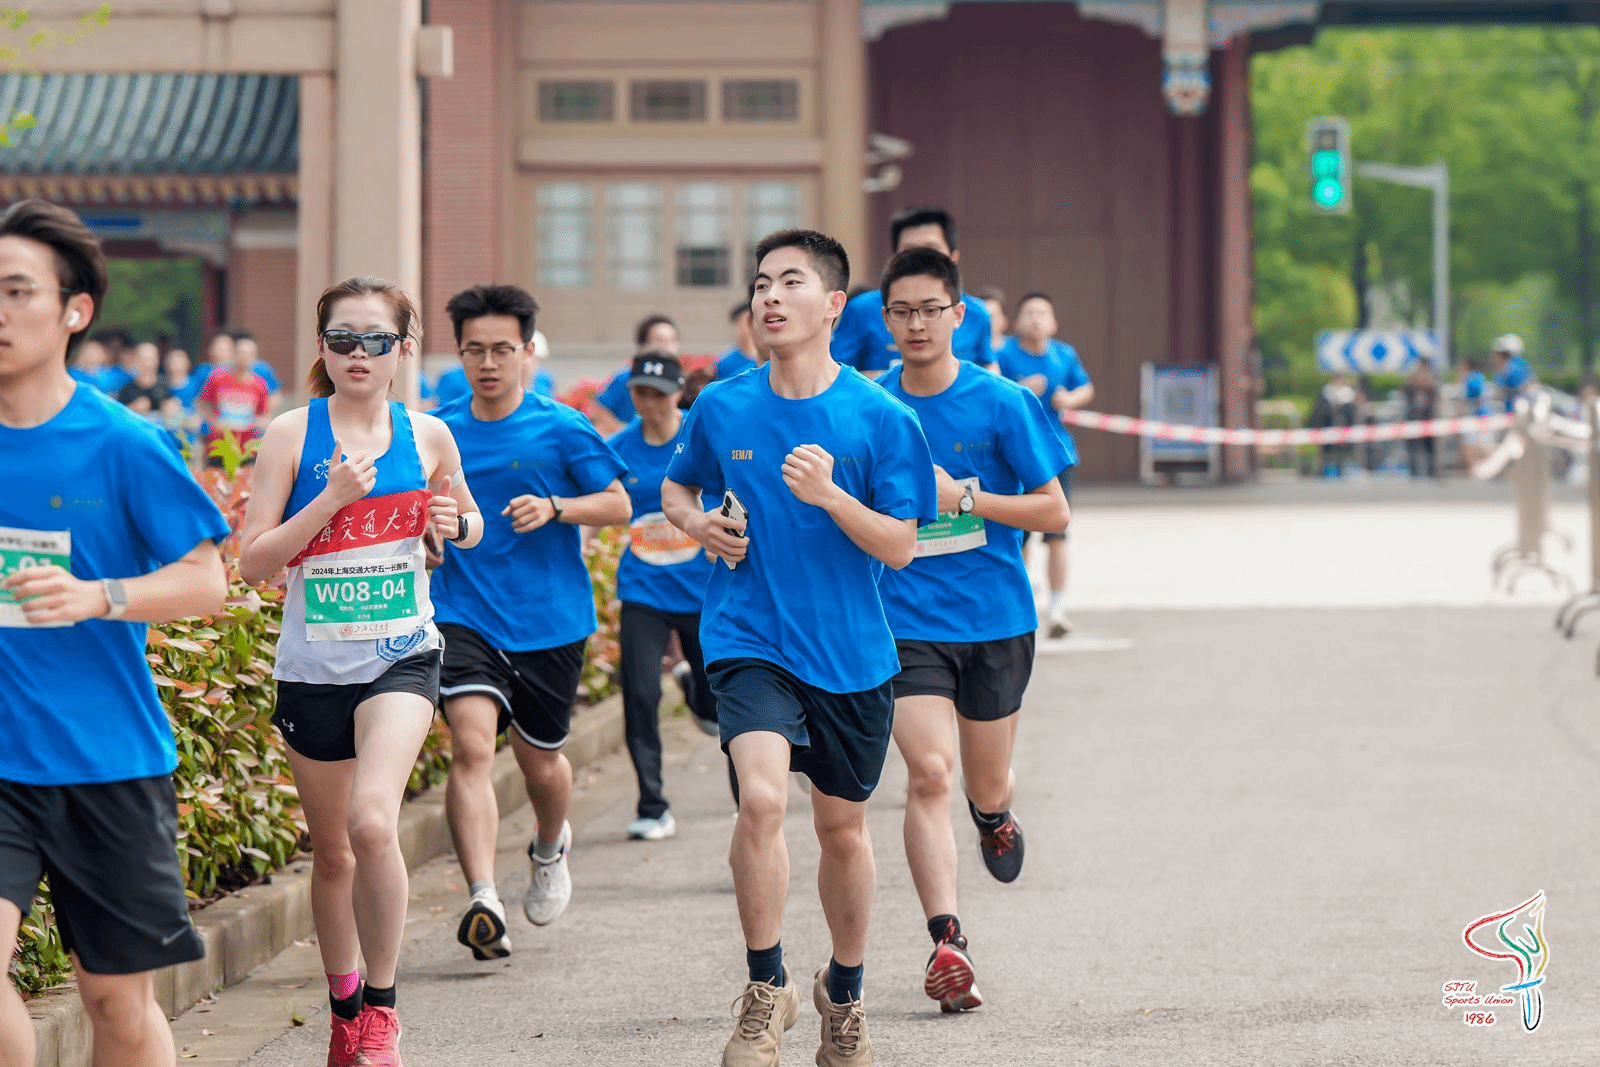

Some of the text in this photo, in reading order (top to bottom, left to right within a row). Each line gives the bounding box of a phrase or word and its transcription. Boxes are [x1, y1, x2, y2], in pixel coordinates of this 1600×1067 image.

[303, 501, 421, 551] 海交通大学
[314, 577, 406, 603] W08-04
